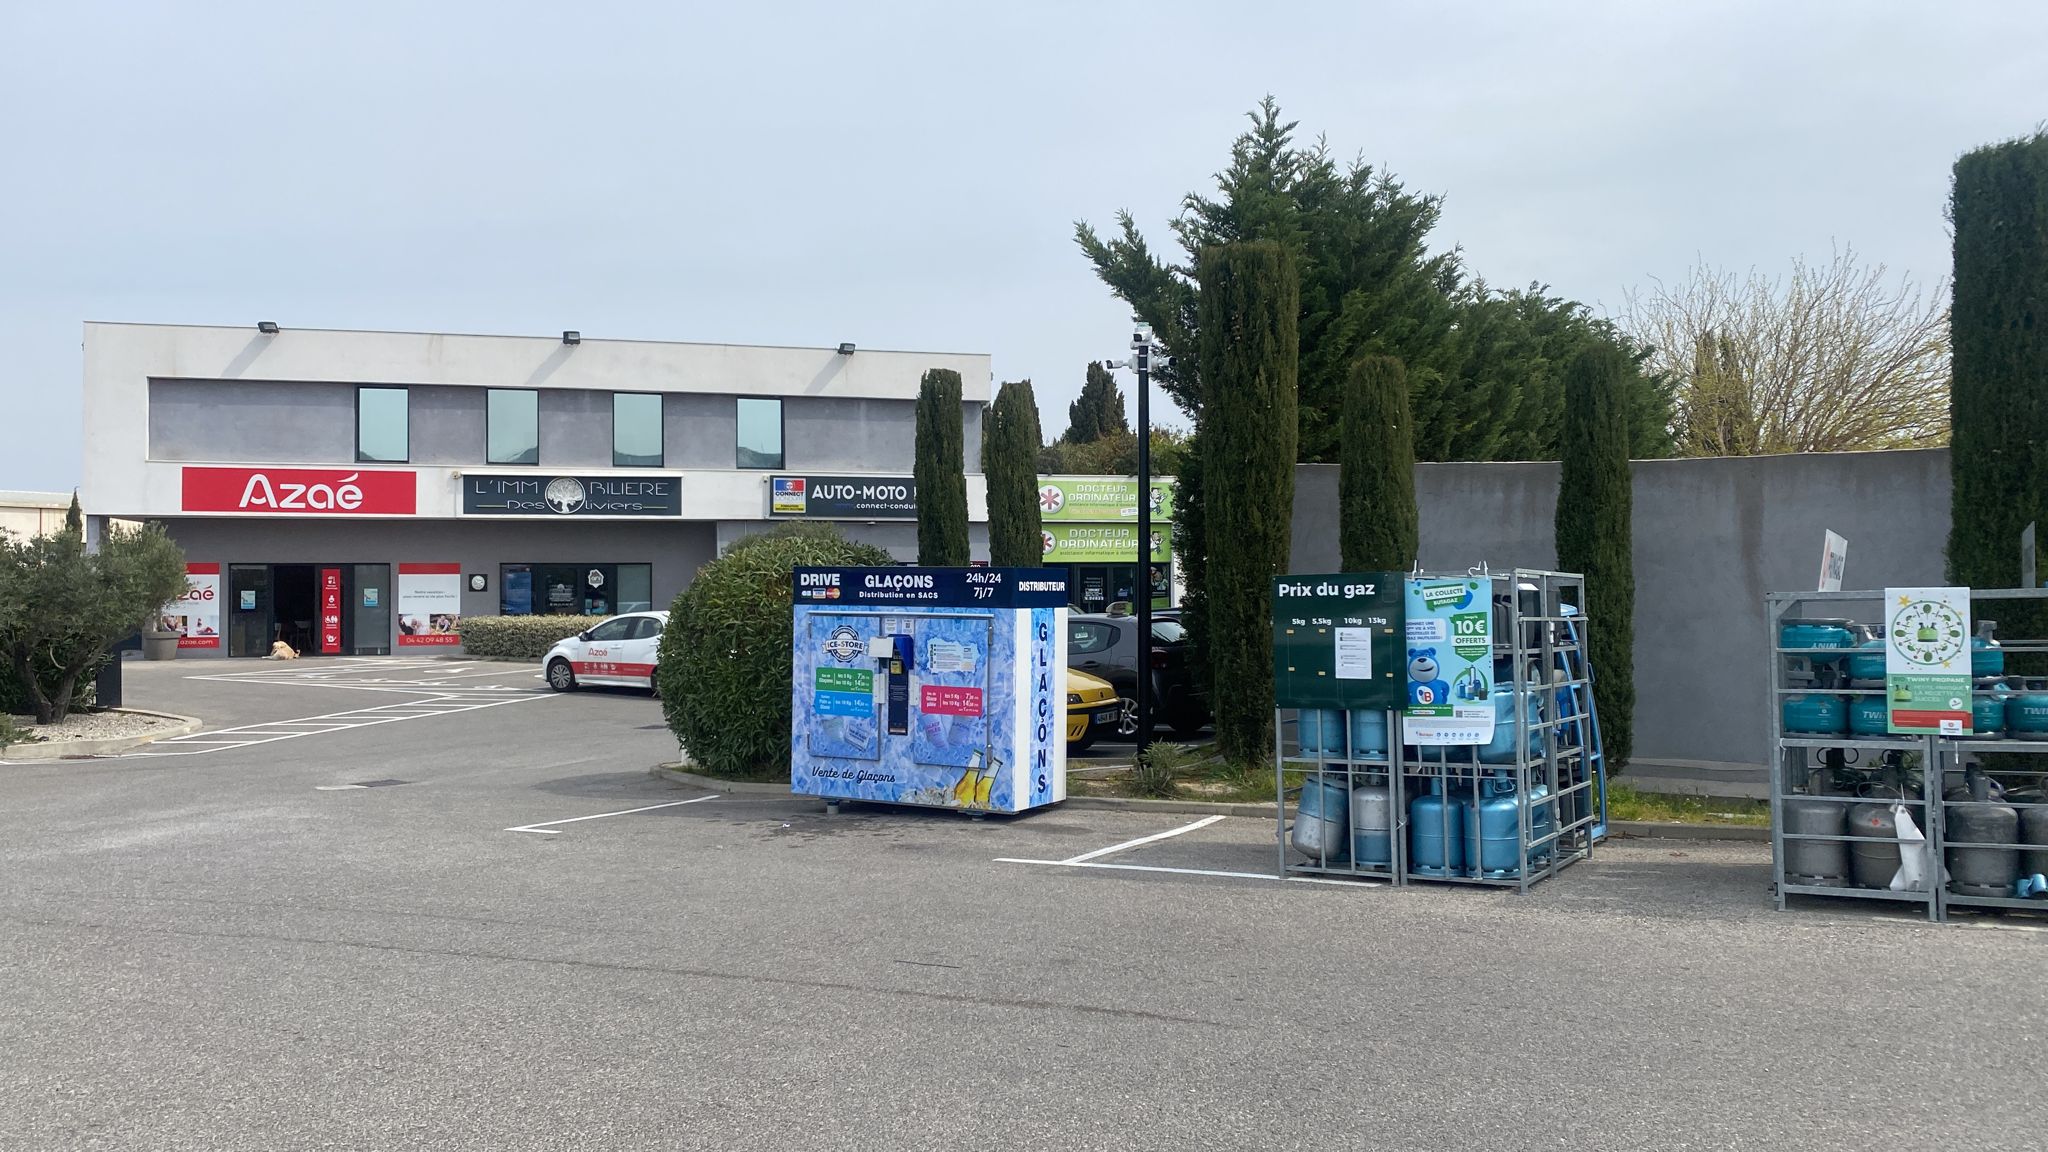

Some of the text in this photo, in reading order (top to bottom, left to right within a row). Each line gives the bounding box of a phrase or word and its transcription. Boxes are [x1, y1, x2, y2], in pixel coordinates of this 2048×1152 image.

[238, 471, 363, 510] Azaé
[811, 484, 907, 501] AUTO-MOTO
[1076, 484, 1128, 493] DOCTEUR
[1068, 493, 1137, 502] ORDINATEUR
[506, 500, 643, 511] Des liviers
[1069, 528, 1130, 538] DOCTEUR
[1059, 539, 1138, 549] ORDINATEUR
[800, 573, 841, 586] DRIVE
[864, 574, 934, 591] GLAÇONS
[966, 573, 1002, 584] 24h/24
[1018, 580, 1065, 592] DISTRIBUTEUR
[1278, 582, 1375, 599] Prix du gaz
[859, 590, 904, 599] Distribution
[918, 591, 939, 599] SACS
[973, 586, 994, 599] 7j/7
[1434, 588, 1464, 597] COLLECTE
[1291, 618, 1306, 626] 5kg
[1344, 617, 1363, 625] 10kg
[1368, 617, 1387, 625] 13kg
[827, 640, 863, 650] ICE-STORE
[1037, 622, 1048, 794] GLAÇONS
[812, 766, 896, 784] Vente de Glaçons
